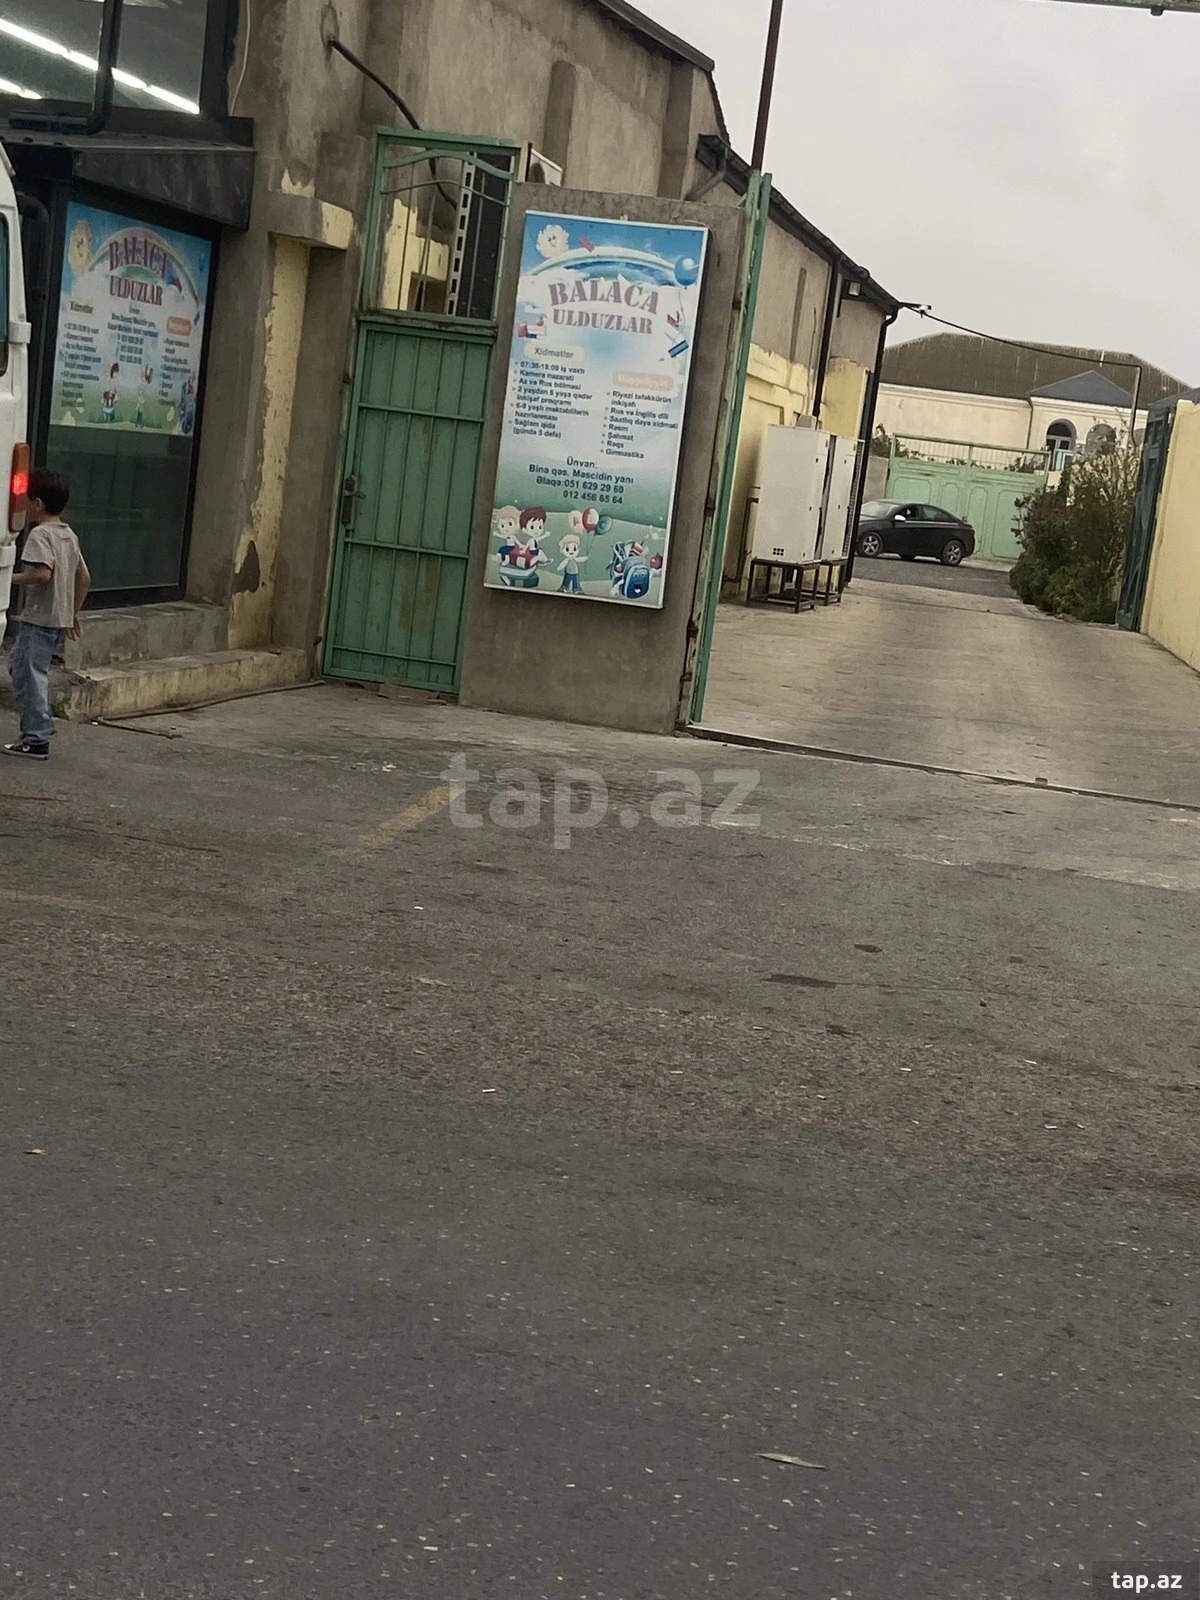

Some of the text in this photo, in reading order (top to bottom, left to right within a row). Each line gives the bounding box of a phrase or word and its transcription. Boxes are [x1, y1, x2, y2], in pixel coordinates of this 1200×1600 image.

[109, 237, 166, 281] BALACA
[110, 275, 163, 306] ULDUZLAR
[548, 280, 659, 315] BALACA
[552, 309, 652, 334] ULDUZLAR
[566, 456, 598, 468] Ünvan:
[529, 464, 634, 484] Binə qəs. Məscidin yanı
[563, 490, 622, 504] 012 456 65 64
[582, 482, 598, 490] 629
[600, 484, 611, 492] 29
[613, 485, 624, 494] 60
